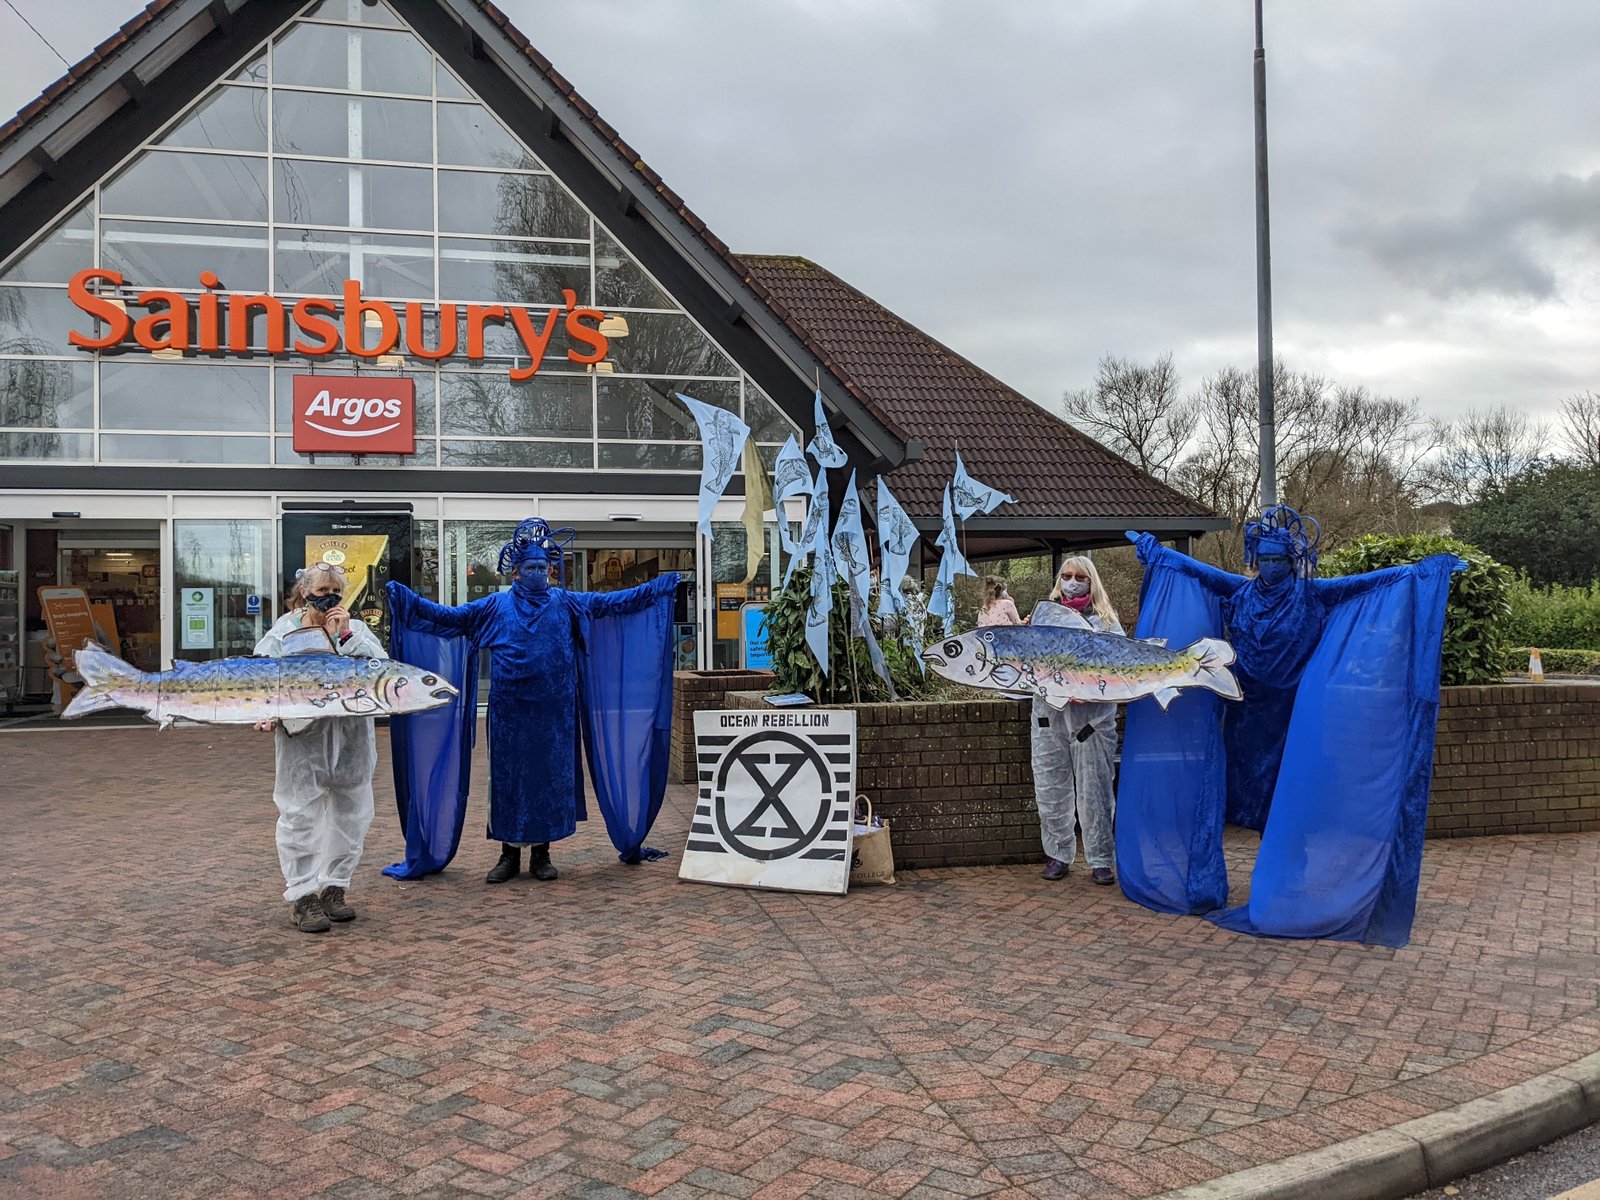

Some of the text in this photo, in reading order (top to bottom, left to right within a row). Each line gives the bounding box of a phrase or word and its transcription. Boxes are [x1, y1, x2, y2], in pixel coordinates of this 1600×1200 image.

[68, 268, 608, 381] Sainsbury's
[305, 390, 402, 425] Argos
[720, 714, 830, 728] OCEAN REBELLION
